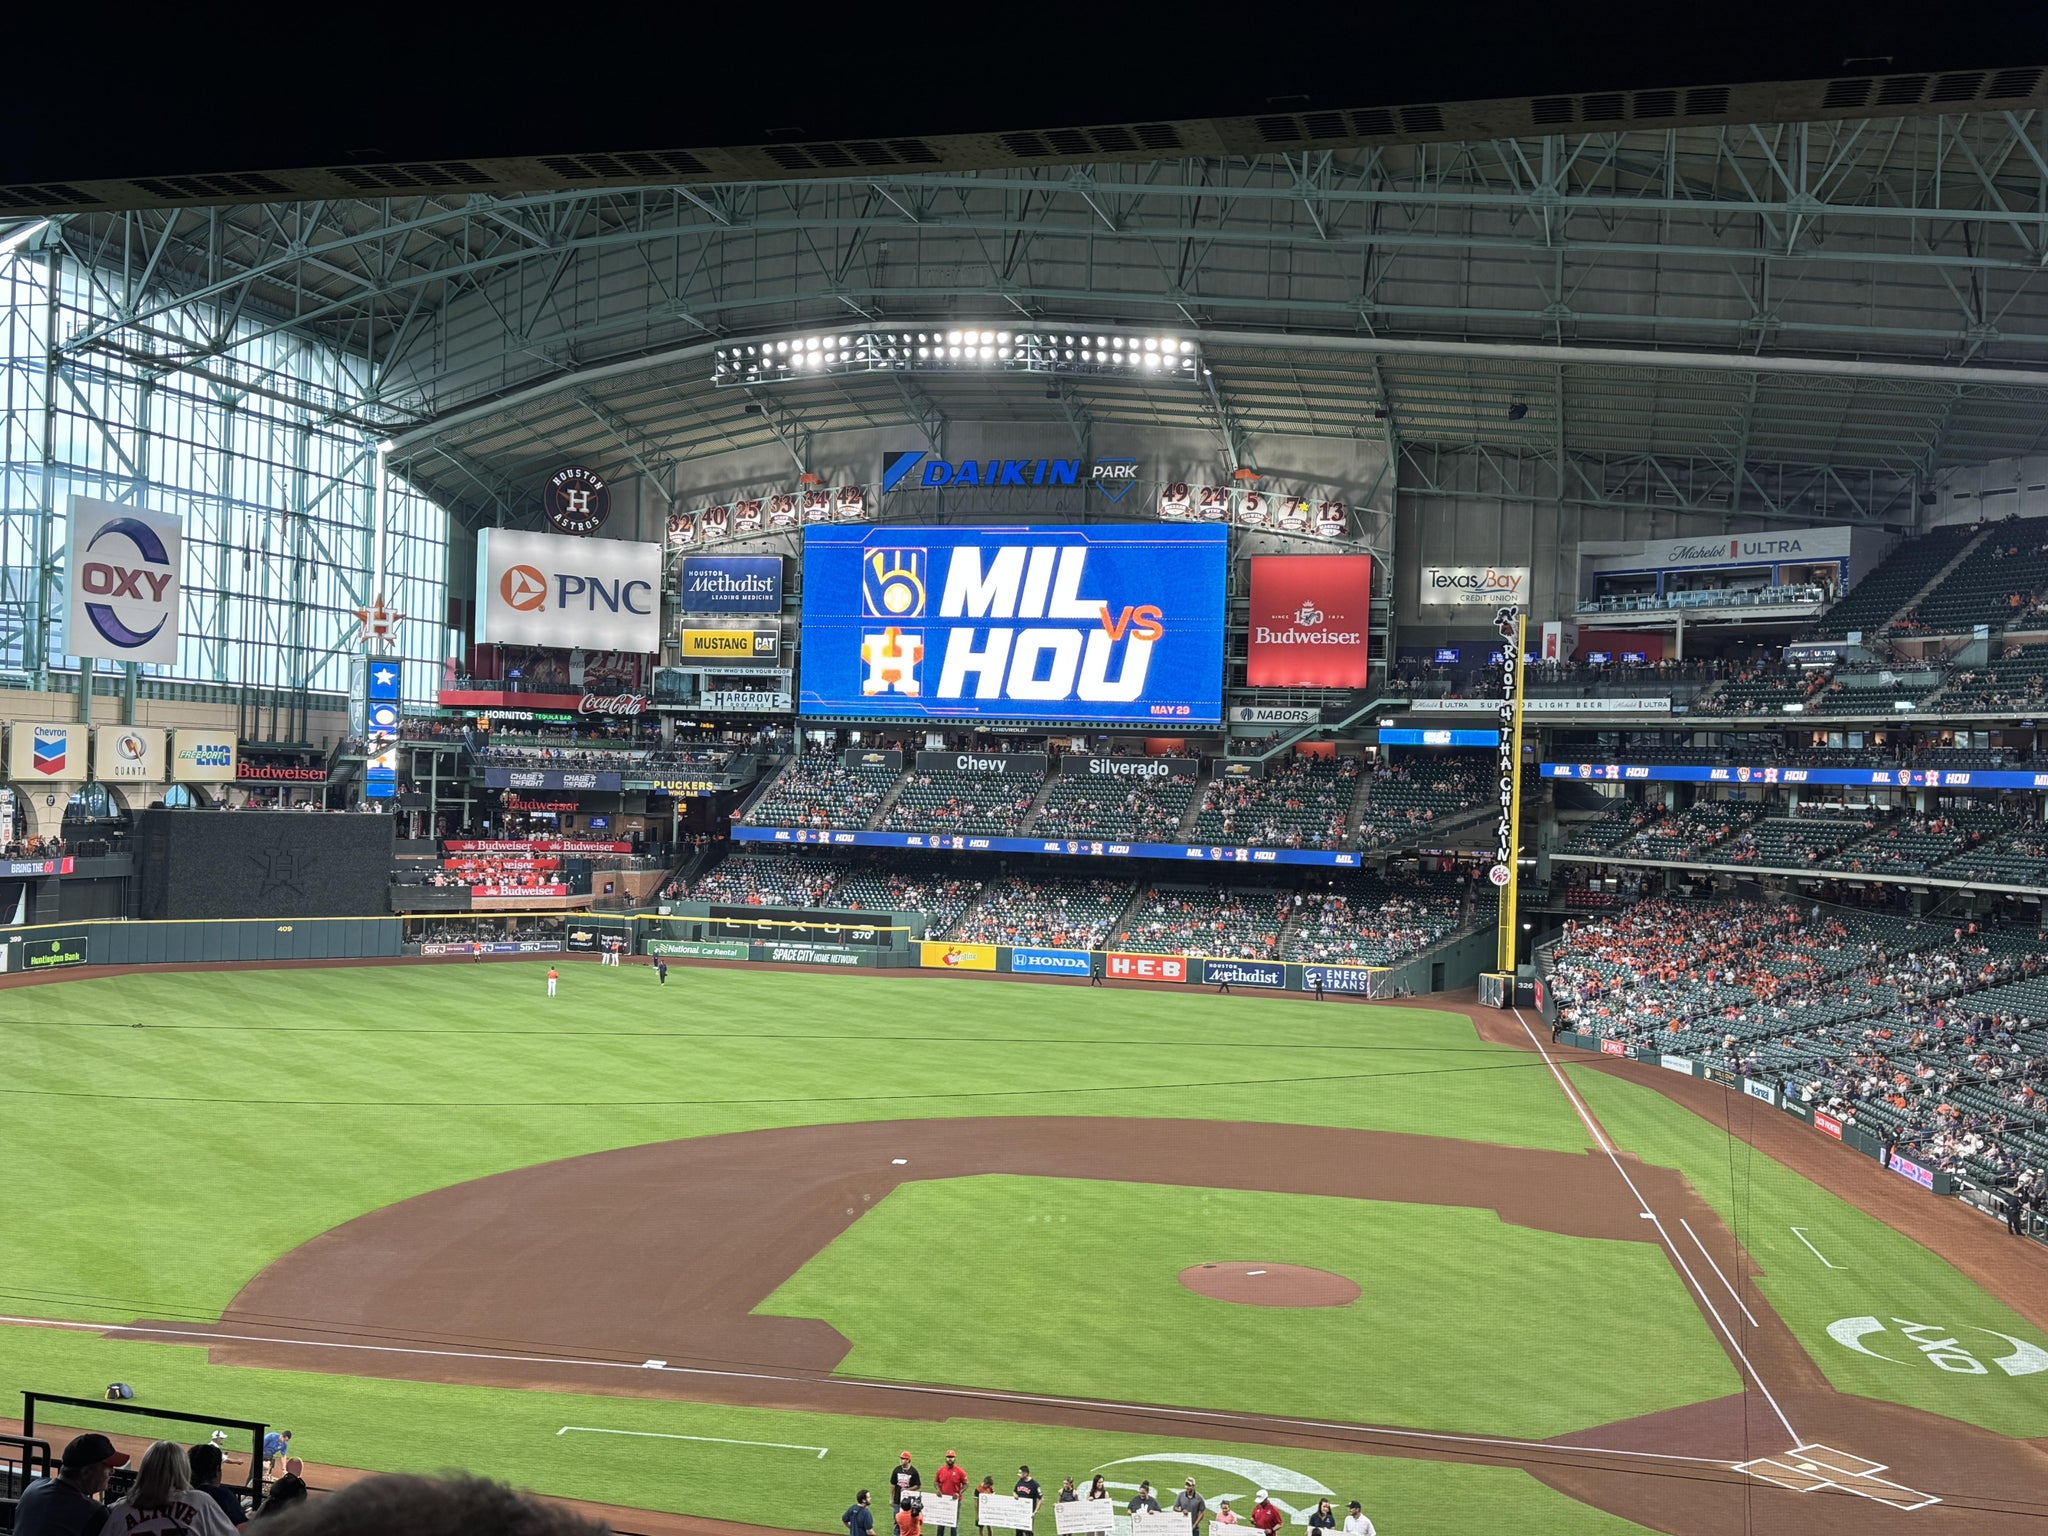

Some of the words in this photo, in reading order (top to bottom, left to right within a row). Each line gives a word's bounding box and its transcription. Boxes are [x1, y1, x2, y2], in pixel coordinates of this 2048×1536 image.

[552, 468, 604, 490] HOUSTON
[921, 459, 1081, 486] DAIKIN
[1092, 464, 1139, 479] PARK
[803, 489, 828, 509] 34
[836, 486, 861, 505] 42
[1162, 483, 1188, 502] 49
[1200, 486, 1226, 506] 24
[770, 495, 792, 514] 33
[1246, 491, 1258, 511] 5
[1286, 497, 1300, 517] 7
[702, 507, 724, 526] 40
[735, 500, 758, 519] 25
[1319, 502, 1344, 521] 13
[554, 513, 600, 531] ASTROS
[669, 514, 691, 533] 32
[1668, 544, 1726, 562] Michelob
[1743, 540, 1802, 555] ULTRA
[82, 562, 173, 602] OXY
[688, 574, 774, 592] Methodist
[939, 546, 1108, 619] MIL
[1428, 570, 1478, 588] Texas
[1486, 569, 1522, 593] Bay
[553, 574, 652, 615] PNC
[1460, 594, 1487, 602] CREDIT
[1490, 594, 1518, 602] UNION
[1099, 605, 1164, 641] VS
[694, 637, 748, 650] MUSTANG
[755, 637, 775, 651] CAT
[1255, 627, 1360, 645] Budweiser
[936, 628, 1153, 702] HOU
[1503, 644, 1515, 699] ROOT
[715, 692, 780, 707] HARGROVE
[485, 711, 534, 720] HORNITOS
[1150, 705, 1174, 715] MAY
[1176, 705, 1190, 715] 29
[1257, 710, 1308, 721] NABORS
[1500, 704, 1513, 721] 4
[34, 726, 67, 738] Chevron
[535, 737, 576, 747] HORNITOS
[178, 749, 226, 760] FREEPORT
[196, 745, 231, 766] LNG
[115, 766, 147, 776] QUANTA
[237, 763, 328, 780] Budweiser
[957, 755, 1007, 773] Chevy
[1089, 759, 1169, 776] Silverado
[1554, 766, 1572, 775] MIL
[1625, 767, 1649, 777] HOU
[510, 773, 539, 781] CHASE
[520, 779, 545, 787] FIGHT
[563, 774, 590, 782] CHASE
[1710, 769, 1729, 779] MIL
[1783, 770, 1807, 781] HOU
[1872, 772, 1891, 782] MIL
[1945, 773, 1970, 784] HOU
[653, 781, 714, 790] PLUCKERS
[509, 796, 580, 811] Budweiser
[775, 831, 791, 839] MIL
[835, 834, 855, 842] HOU
[907, 837, 923, 845] MIL
[969, 839, 989, 848] HOU
[477, 841, 532, 851] Budweiser
[563, 841, 614, 851] Budweiser
[1044, 842, 1061, 851] MIL
[1108, 845, 1129, 854] HOU
[1186, 848, 1204, 857] MIL
[1254, 851, 1276, 860] HOU
[1335, 854, 1354, 864] MIL
[11, 863, 32, 874] BRING
[32, 862, 44, 873] THE
[500, 885, 556, 896] Budweiser
[852, 931, 871, 940] 370
[668, 945, 700, 954] National
[702, 947, 714, 955] Car
[714, 948, 737, 956] Rental
[772, 948, 797, 961] SPACE
[797, 950, 815, 962] CITY
[814, 952, 831, 963] HOME
[831, 954, 859, 965] NETWORK
[31, 955, 64, 966] Huntington
[64, 952, 80, 962] Bank
[1028, 956, 1088, 968] HONDA
[1112, 958, 1181, 977] H-E-B
[1209, 967, 1277, 984] Methodist
[1326, 969, 1367, 980] ENERG
[1328, 979, 1365, 990] TRANS
[1890, 1317, 1988, 1375] OXY
